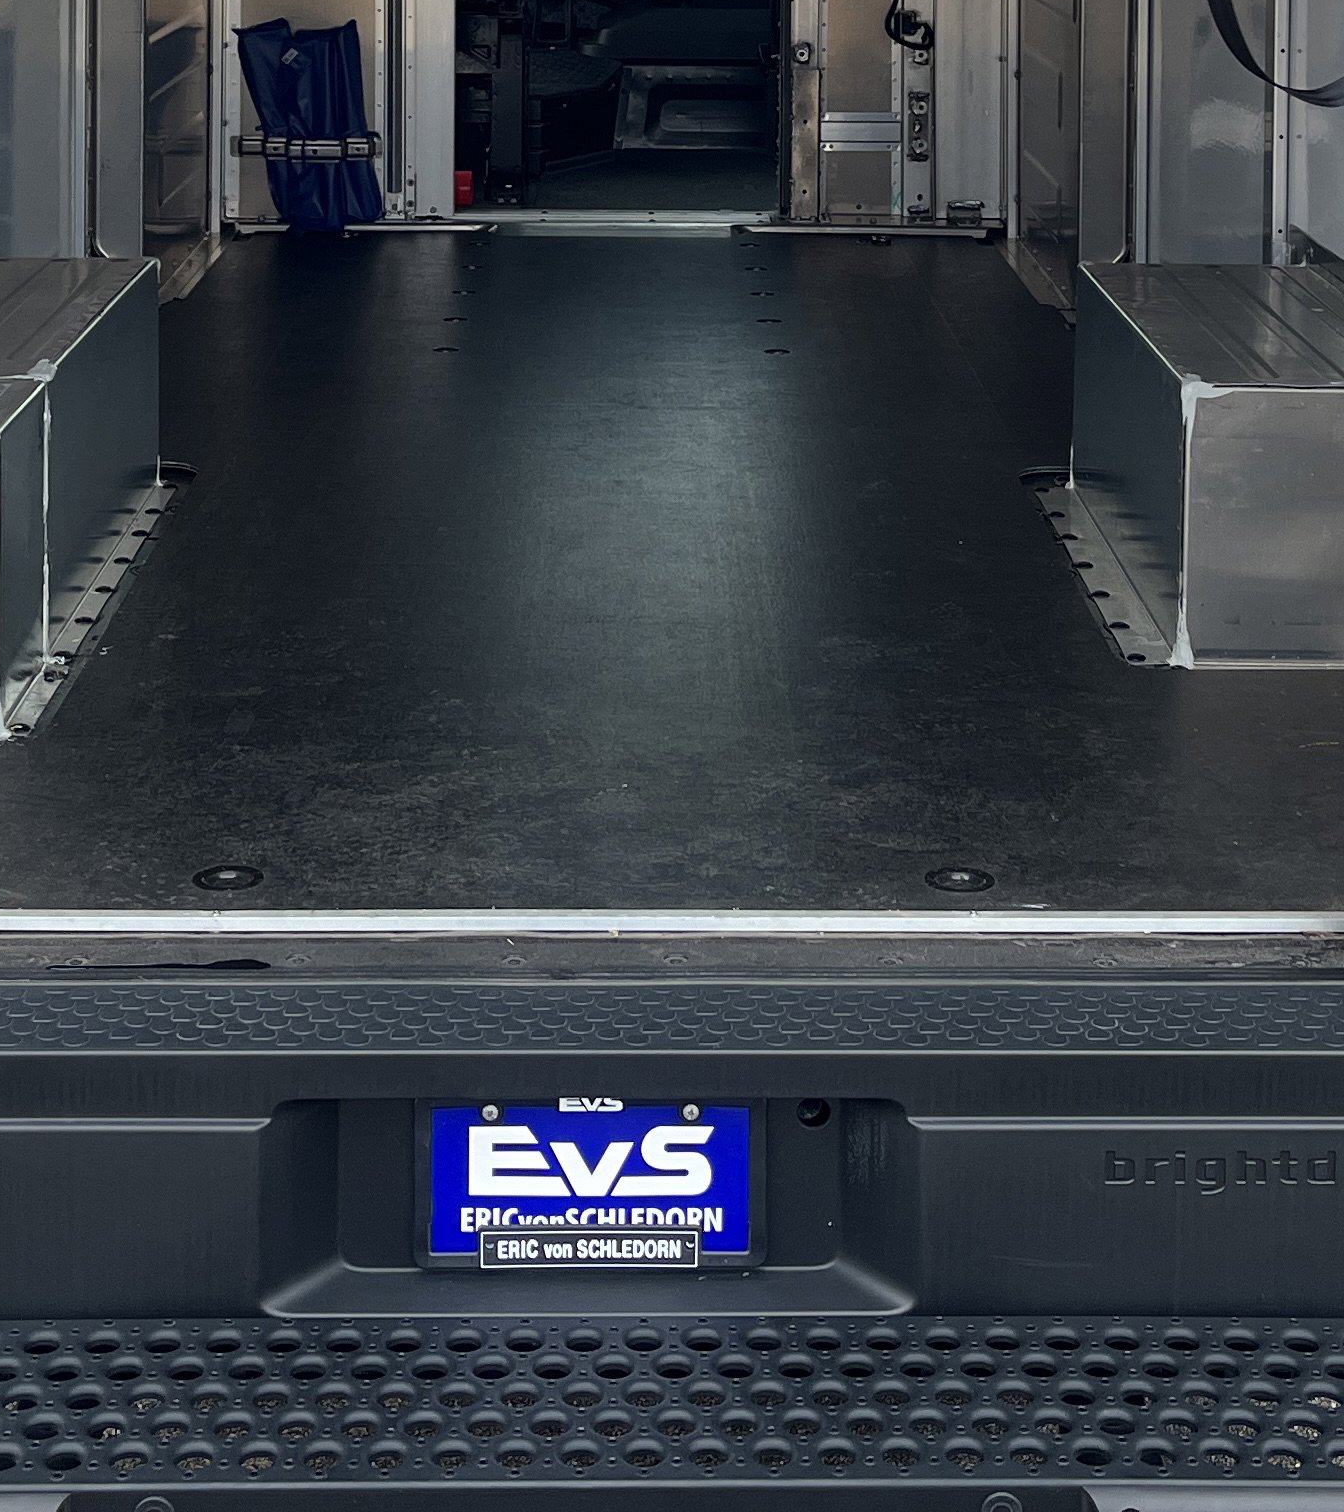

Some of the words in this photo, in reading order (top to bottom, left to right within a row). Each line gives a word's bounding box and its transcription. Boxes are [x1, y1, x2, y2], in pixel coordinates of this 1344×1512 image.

[497, 1239, 538, 1259] ERIC
[543, 1242, 572, 1259] von
[576, 1239, 682, 1259] SCHLEDORN
